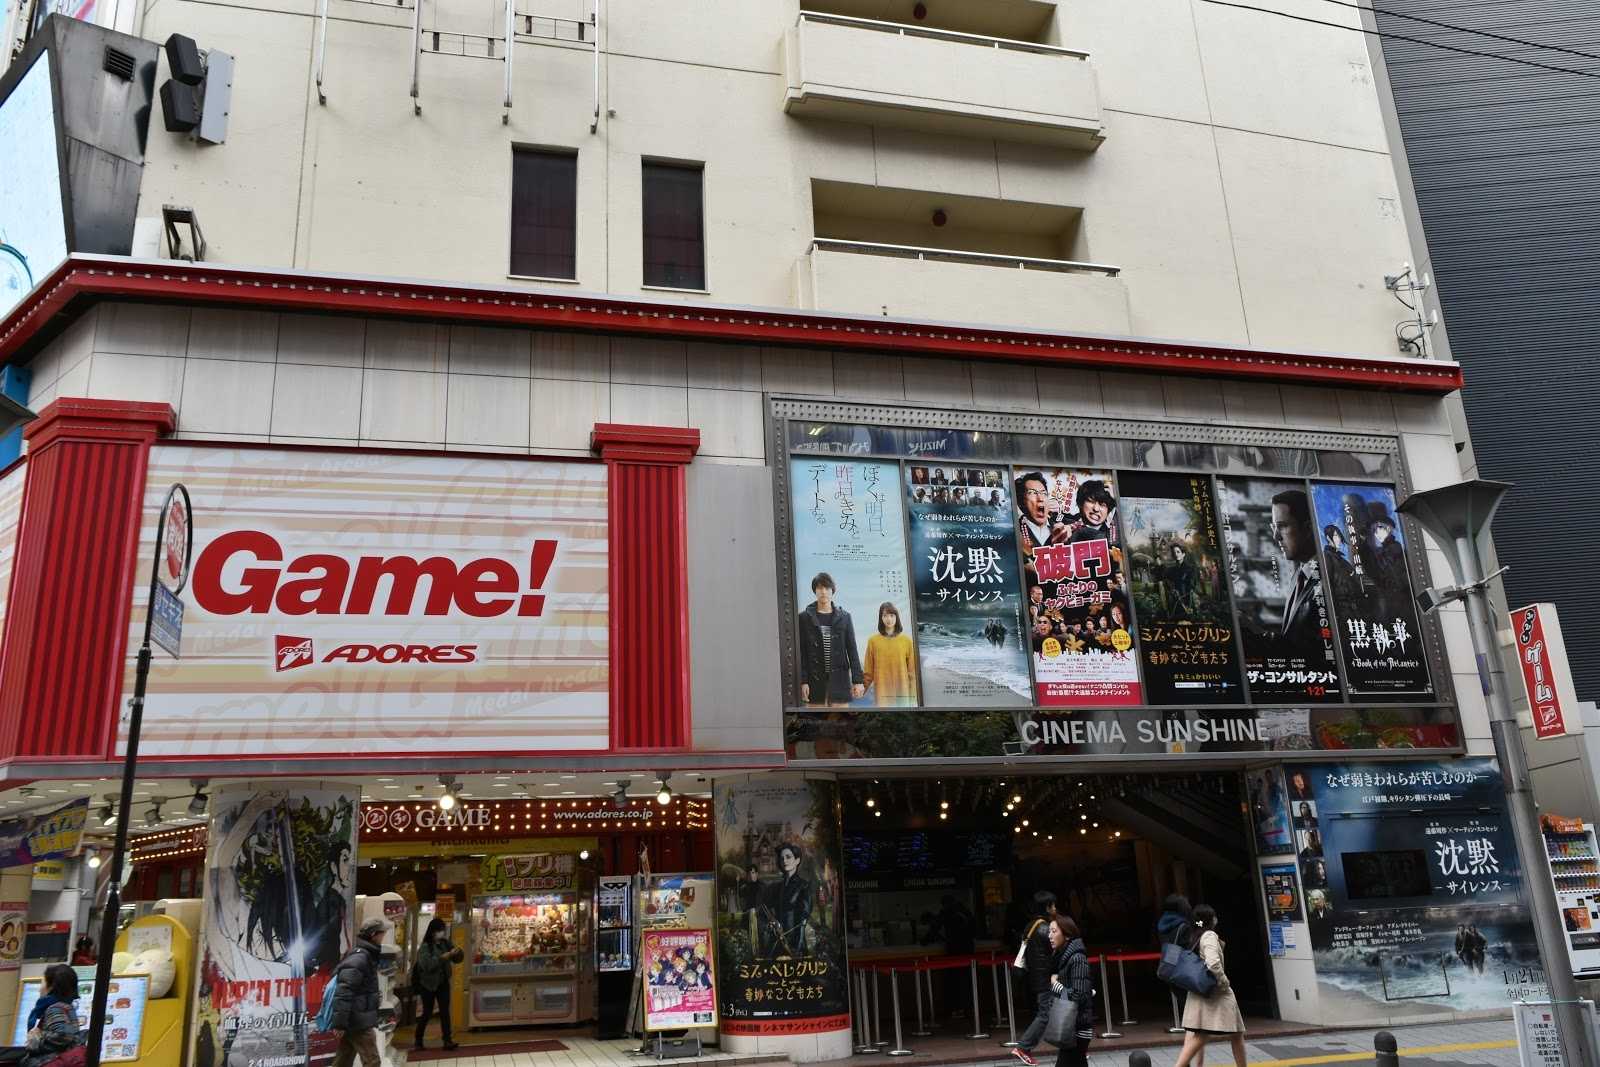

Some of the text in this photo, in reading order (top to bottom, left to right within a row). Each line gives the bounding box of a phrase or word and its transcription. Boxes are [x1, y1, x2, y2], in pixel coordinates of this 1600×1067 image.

[928, 546, 1004, 584] 沈黙
[1033, 539, 1112, 584] 破門
[192, 530, 559, 618] Game!
[1056, 581, 1098, 597] ふたりの
[321, 644, 478, 664] ADORES
[1246, 670, 1338, 684] ザ・コンサルタント
[1526, 640, 1553, 702] ゲーム
[1021, 718, 1270, 744] CINEMA SUNSHINE
[416, 808, 492, 827] GAME
[552, 807, 654, 822] www.adores.co.jp
[1434, 838, 1500, 877] 沈黙
[739, 960, 829, 979] ミス・ペレグリン
